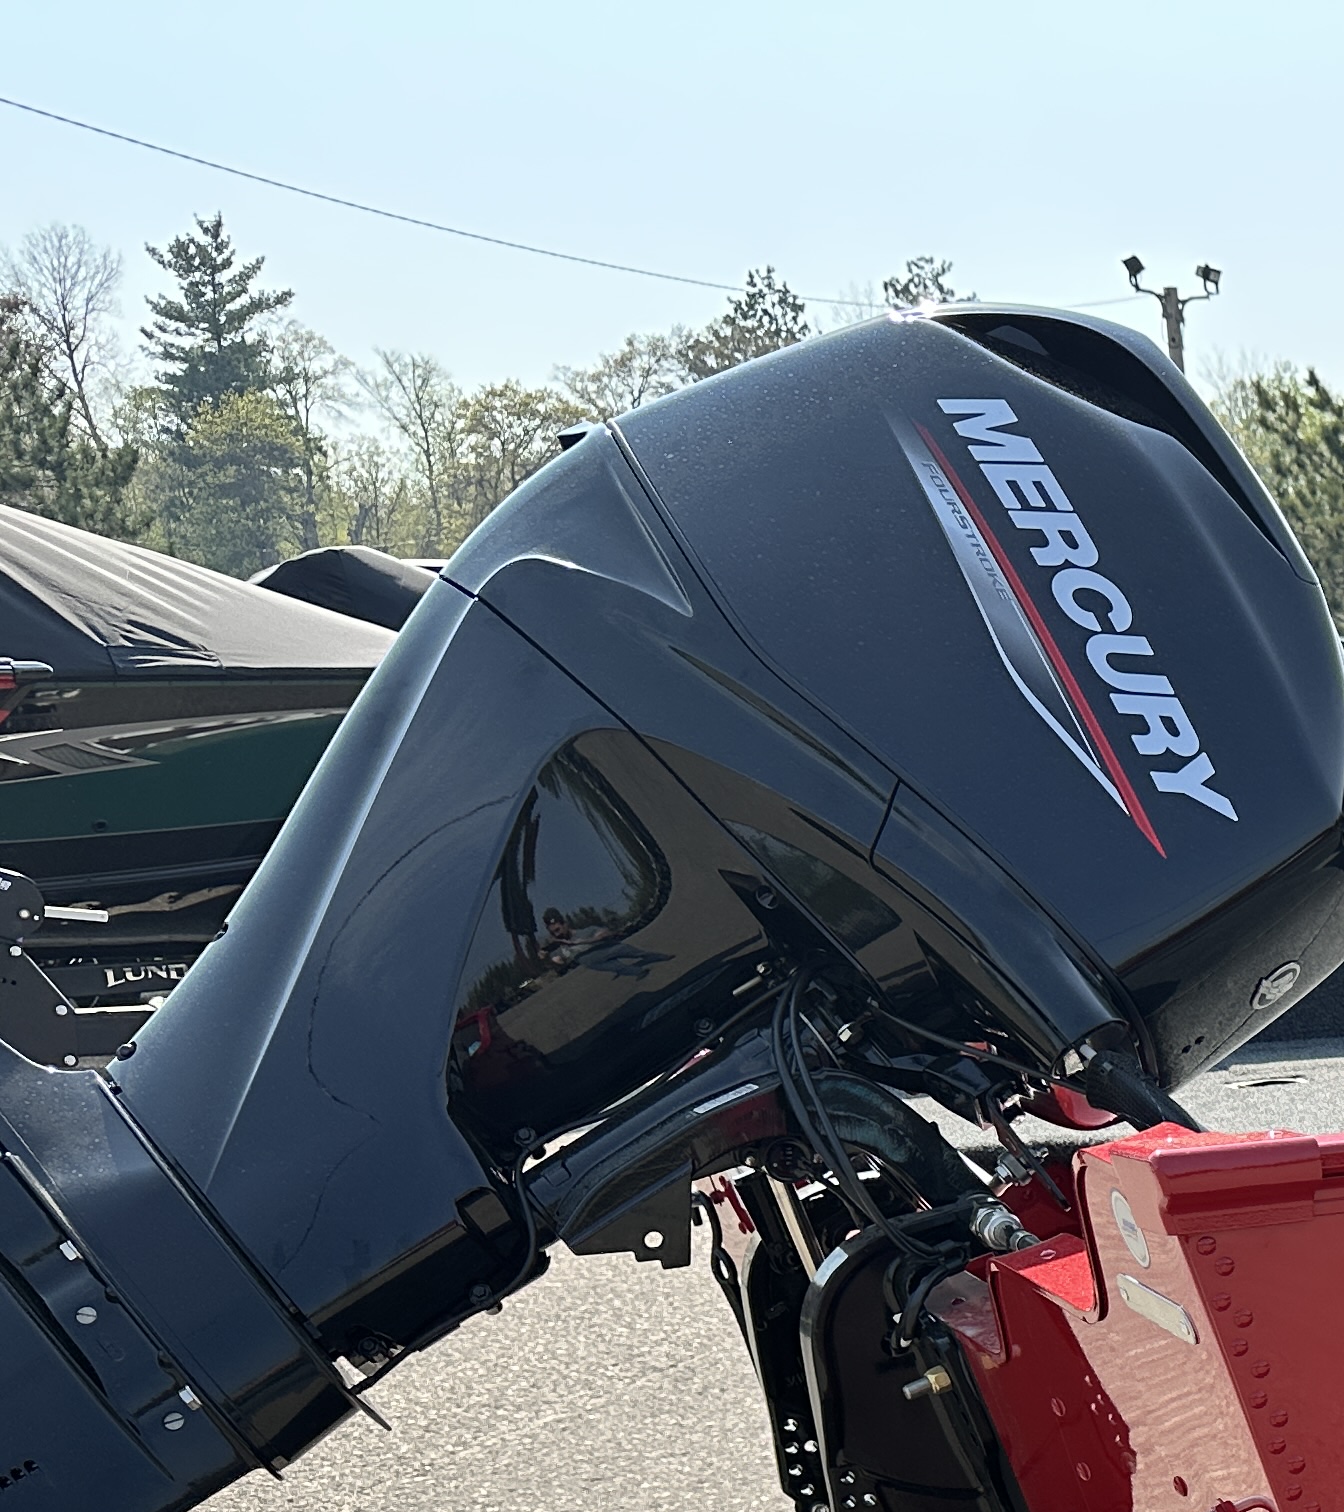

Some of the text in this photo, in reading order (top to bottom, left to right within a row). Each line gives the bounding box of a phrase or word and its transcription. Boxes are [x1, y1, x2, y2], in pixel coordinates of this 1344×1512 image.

[920, 460, 1014, 602] FOURSTROKE
[936, 397, 1239, 822] MERCURY
[103, 962, 190, 989] LUND
